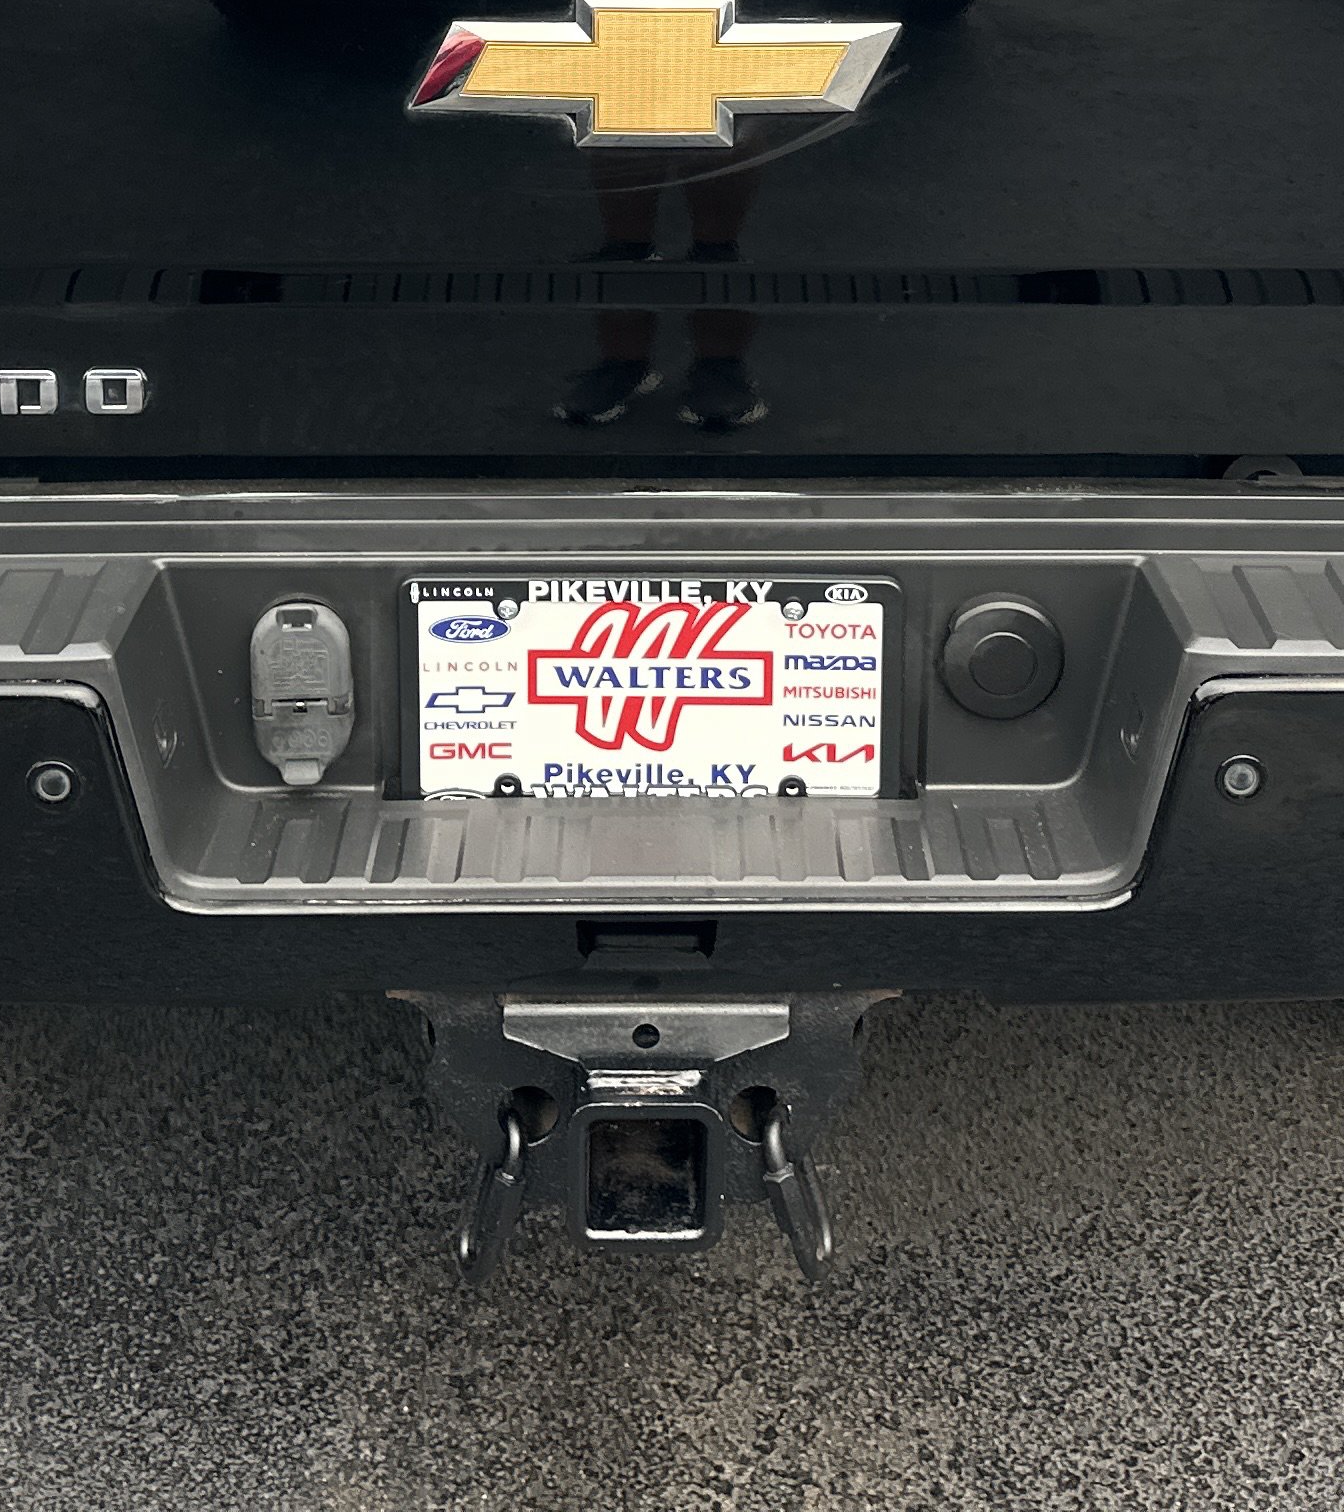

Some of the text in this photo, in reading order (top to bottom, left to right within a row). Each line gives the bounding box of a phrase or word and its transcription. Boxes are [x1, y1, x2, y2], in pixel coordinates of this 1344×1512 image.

[422, 587, 494, 597] LINCOLN
[528, 580, 773, 606] PIKEVILLE, KY
[830, 587, 862, 601] KIA
[444, 618, 495, 640] Ford
[784, 623, 877, 640] TOYOTA
[422, 661, 518, 672] LINCOLN
[553, 666, 752, 689] WALTERS
[783, 686, 877, 700] MITSUBISHI
[423, 720, 518, 731] CHEVROLET
[782, 714, 876, 728] NISSAN
[429, 742, 513, 760] GMC
[544, 762, 757, 785] Pikeville, KY
